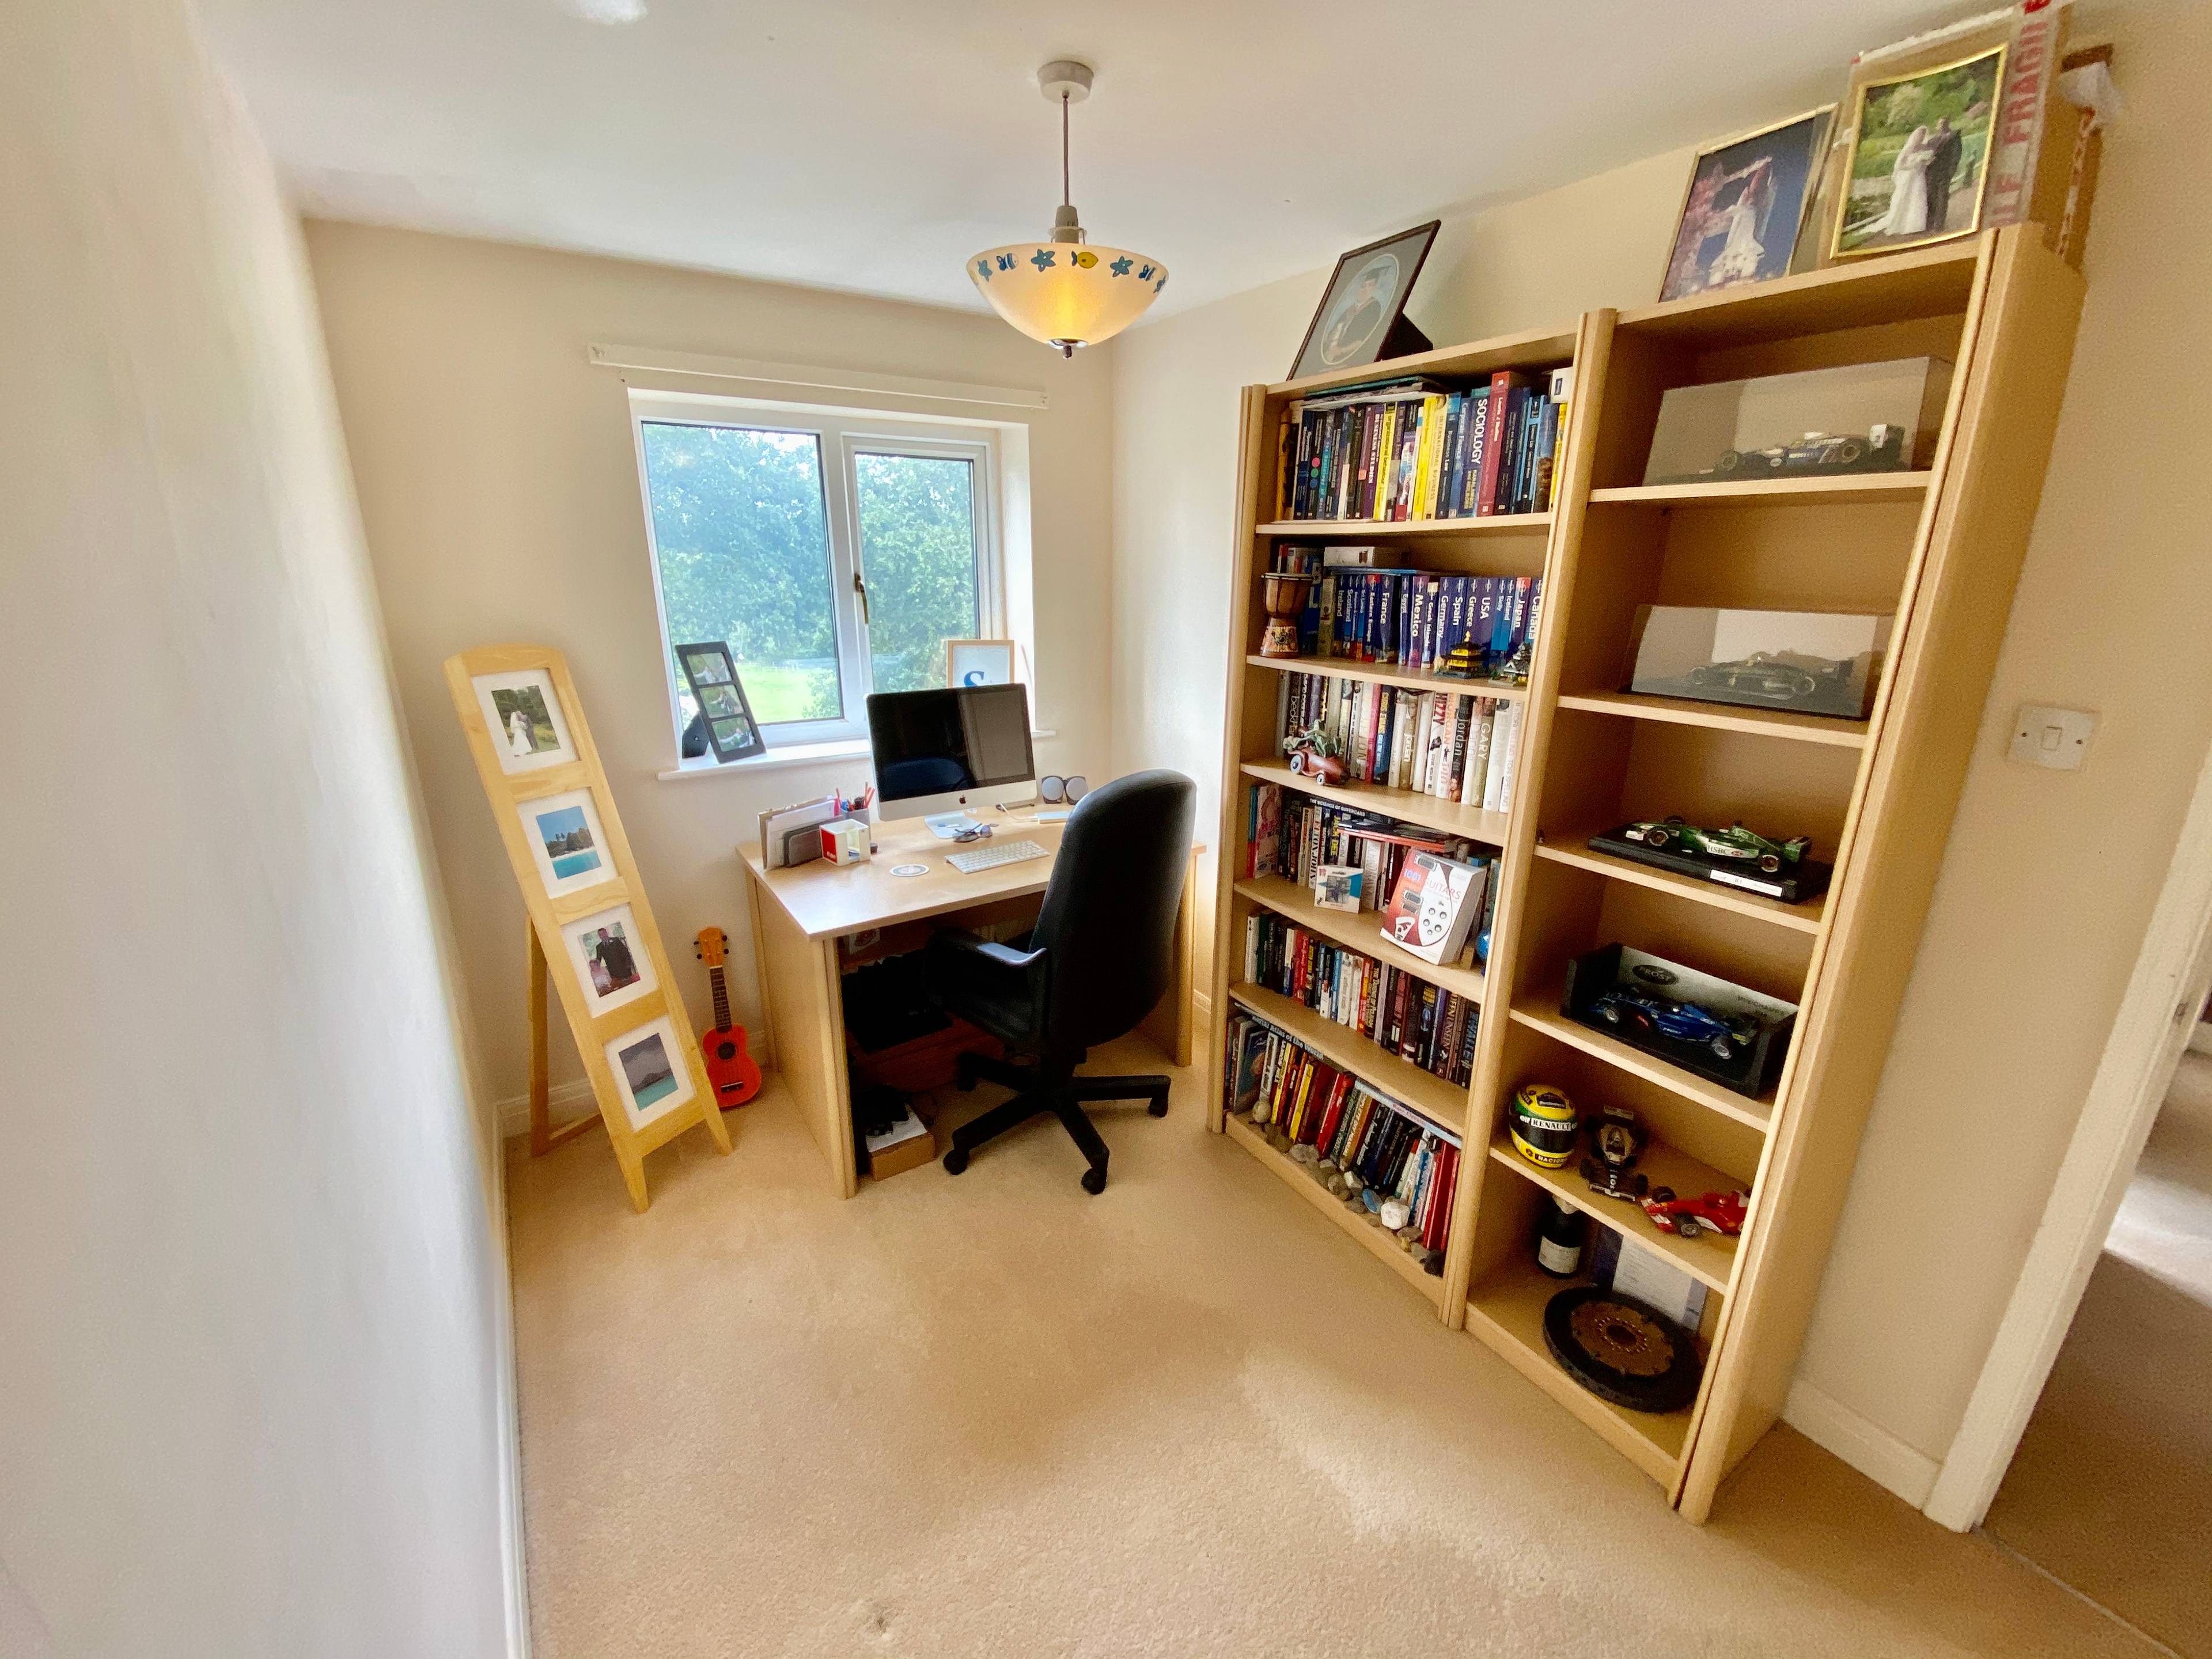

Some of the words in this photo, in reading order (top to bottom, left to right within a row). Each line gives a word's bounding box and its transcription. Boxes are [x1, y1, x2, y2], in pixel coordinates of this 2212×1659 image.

[1371, 414, 1380, 450] BUSINESS
[1384, 415, 1393, 456] organizational
[1434, 415, 1444, 467] INTERNATIONAL
[1471, 398, 1488, 464] SOCIOLOGY
[1368, 452, 1376, 484] STUDIES
[1380, 457, 1388, 485] behaviour
[1336, 590, 1345, 617] Ireland
[1345, 589, 1354, 623] Scotland
[1380, 592, 1390, 624] France
[1412, 594, 1423, 637] Mexico
[1437, 595, 1449, 638] Germany
[1452, 596, 1463, 626] Spain
[1466, 596, 1477, 627] Greece
[1480, 597, 1491, 619] USA
[1504, 595, 1513, 621] Iceland
[1514, 599, 1526, 628] Japan
[1528, 596, 1541, 640] Canada
[1377, 713, 1387, 734] EVANS
[1454, 718, 1469, 757] Jordan
[1478, 723, 1491, 760] GARY
[1313, 820, 1321, 852] ELTON
[1331, 815, 1341, 837] JACK
[1330, 839, 1339, 857] DEE
[1707, 844, 1730, 855] HSBC
[1309, 852, 1317, 880] JOHN
[1442, 1016, 1455, 1048] UNSEEN
[1520, 1115, 1531, 1124] elf
[1533, 1120, 1572, 1131] RENAULT
